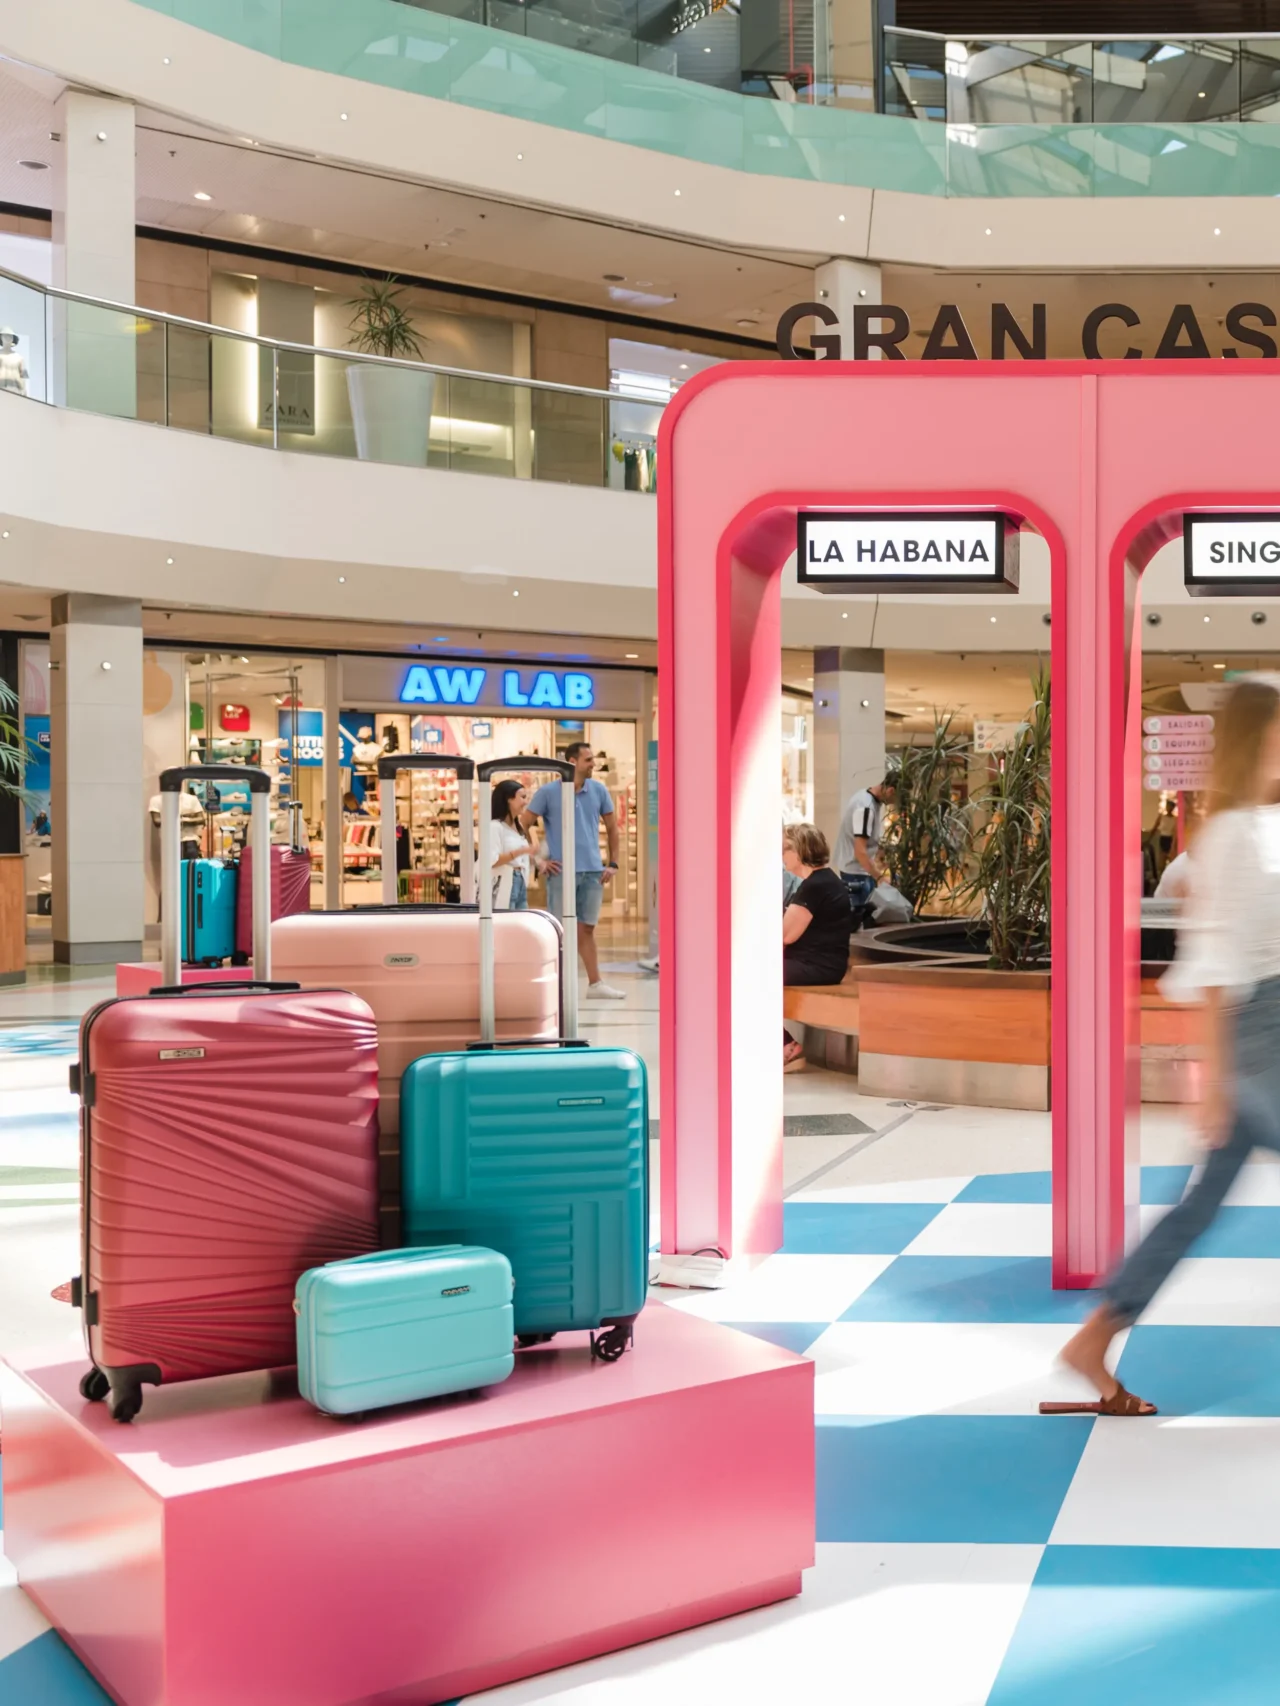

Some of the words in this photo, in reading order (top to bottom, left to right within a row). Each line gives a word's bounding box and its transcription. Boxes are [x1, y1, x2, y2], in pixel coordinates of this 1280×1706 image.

[776, 302, 1047, 360] GRAN
[809, 540, 844, 562] LA
[857, 540, 989, 562] HABANA
[401, 664, 487, 704] AW
[503, 669, 594, 709] LAB
[1167, 778, 1206, 786] SORTEO
